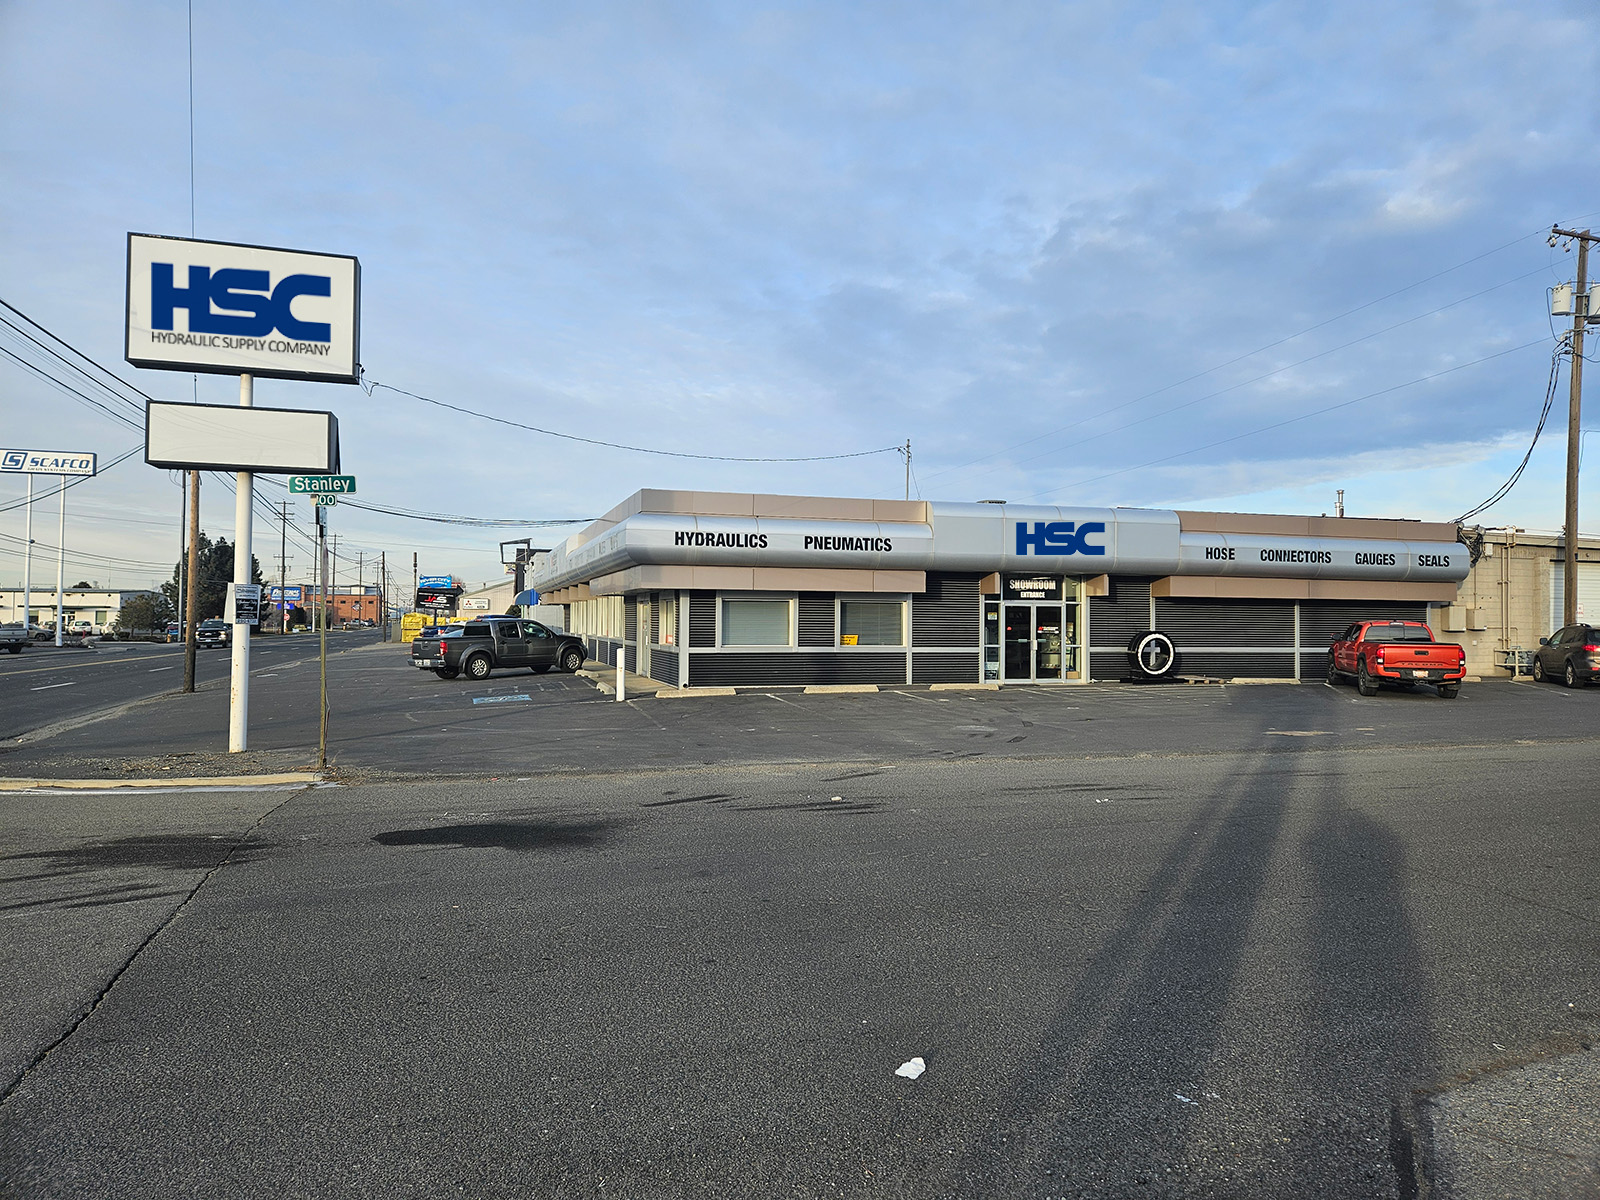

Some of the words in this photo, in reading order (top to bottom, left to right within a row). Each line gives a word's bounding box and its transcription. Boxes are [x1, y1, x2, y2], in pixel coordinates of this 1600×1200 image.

[151, 262, 331, 342] HSC
[151, 331, 221, 348] HYDRAULIC
[222, 337, 267, 351] SUPPLY
[269, 340, 331, 356] COMPANY
[29, 457, 90, 469] SCAFCO
[294, 477, 350, 493] Stanley
[674, 531, 768, 549] HYDRAULICS
[804, 535, 893, 552] PNEUMATICS
[1015, 521, 1106, 556] HSC
[1205, 547, 1236, 560] HOSE
[1260, 548, 1332, 564] CONNECTORS
[1354, 552, 1396, 566] GAUGES
[1417, 554, 1450, 568] SEALS
[1009, 579, 1056, 590] SHOWROOM
[1020, 591, 1045, 599] ENTRANCE
